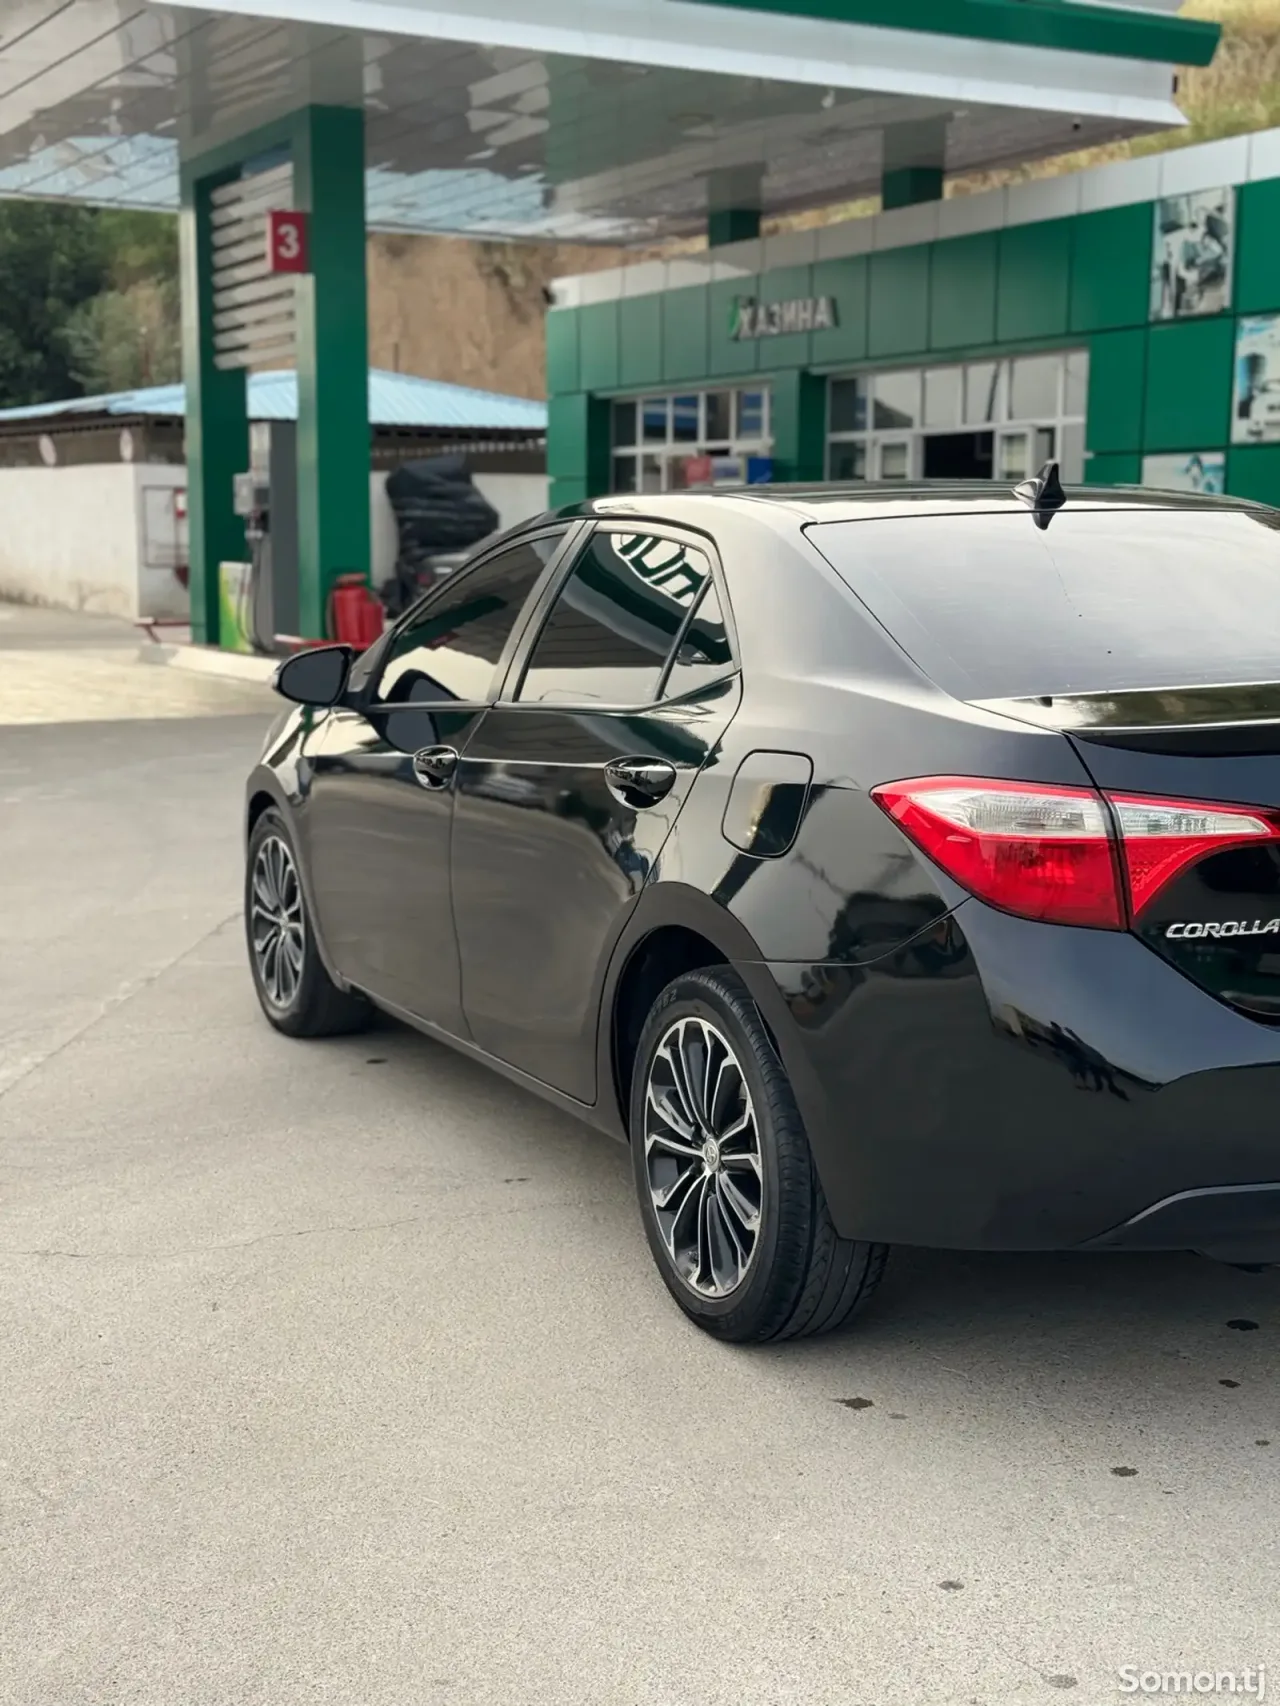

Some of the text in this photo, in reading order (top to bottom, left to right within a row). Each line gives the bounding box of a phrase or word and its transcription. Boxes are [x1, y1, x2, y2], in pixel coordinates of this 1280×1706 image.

[277, 223, 300, 259] 3
[733, 296, 836, 339] ХАЗИНА
[1166, 919, 1280, 938] COROLLA
